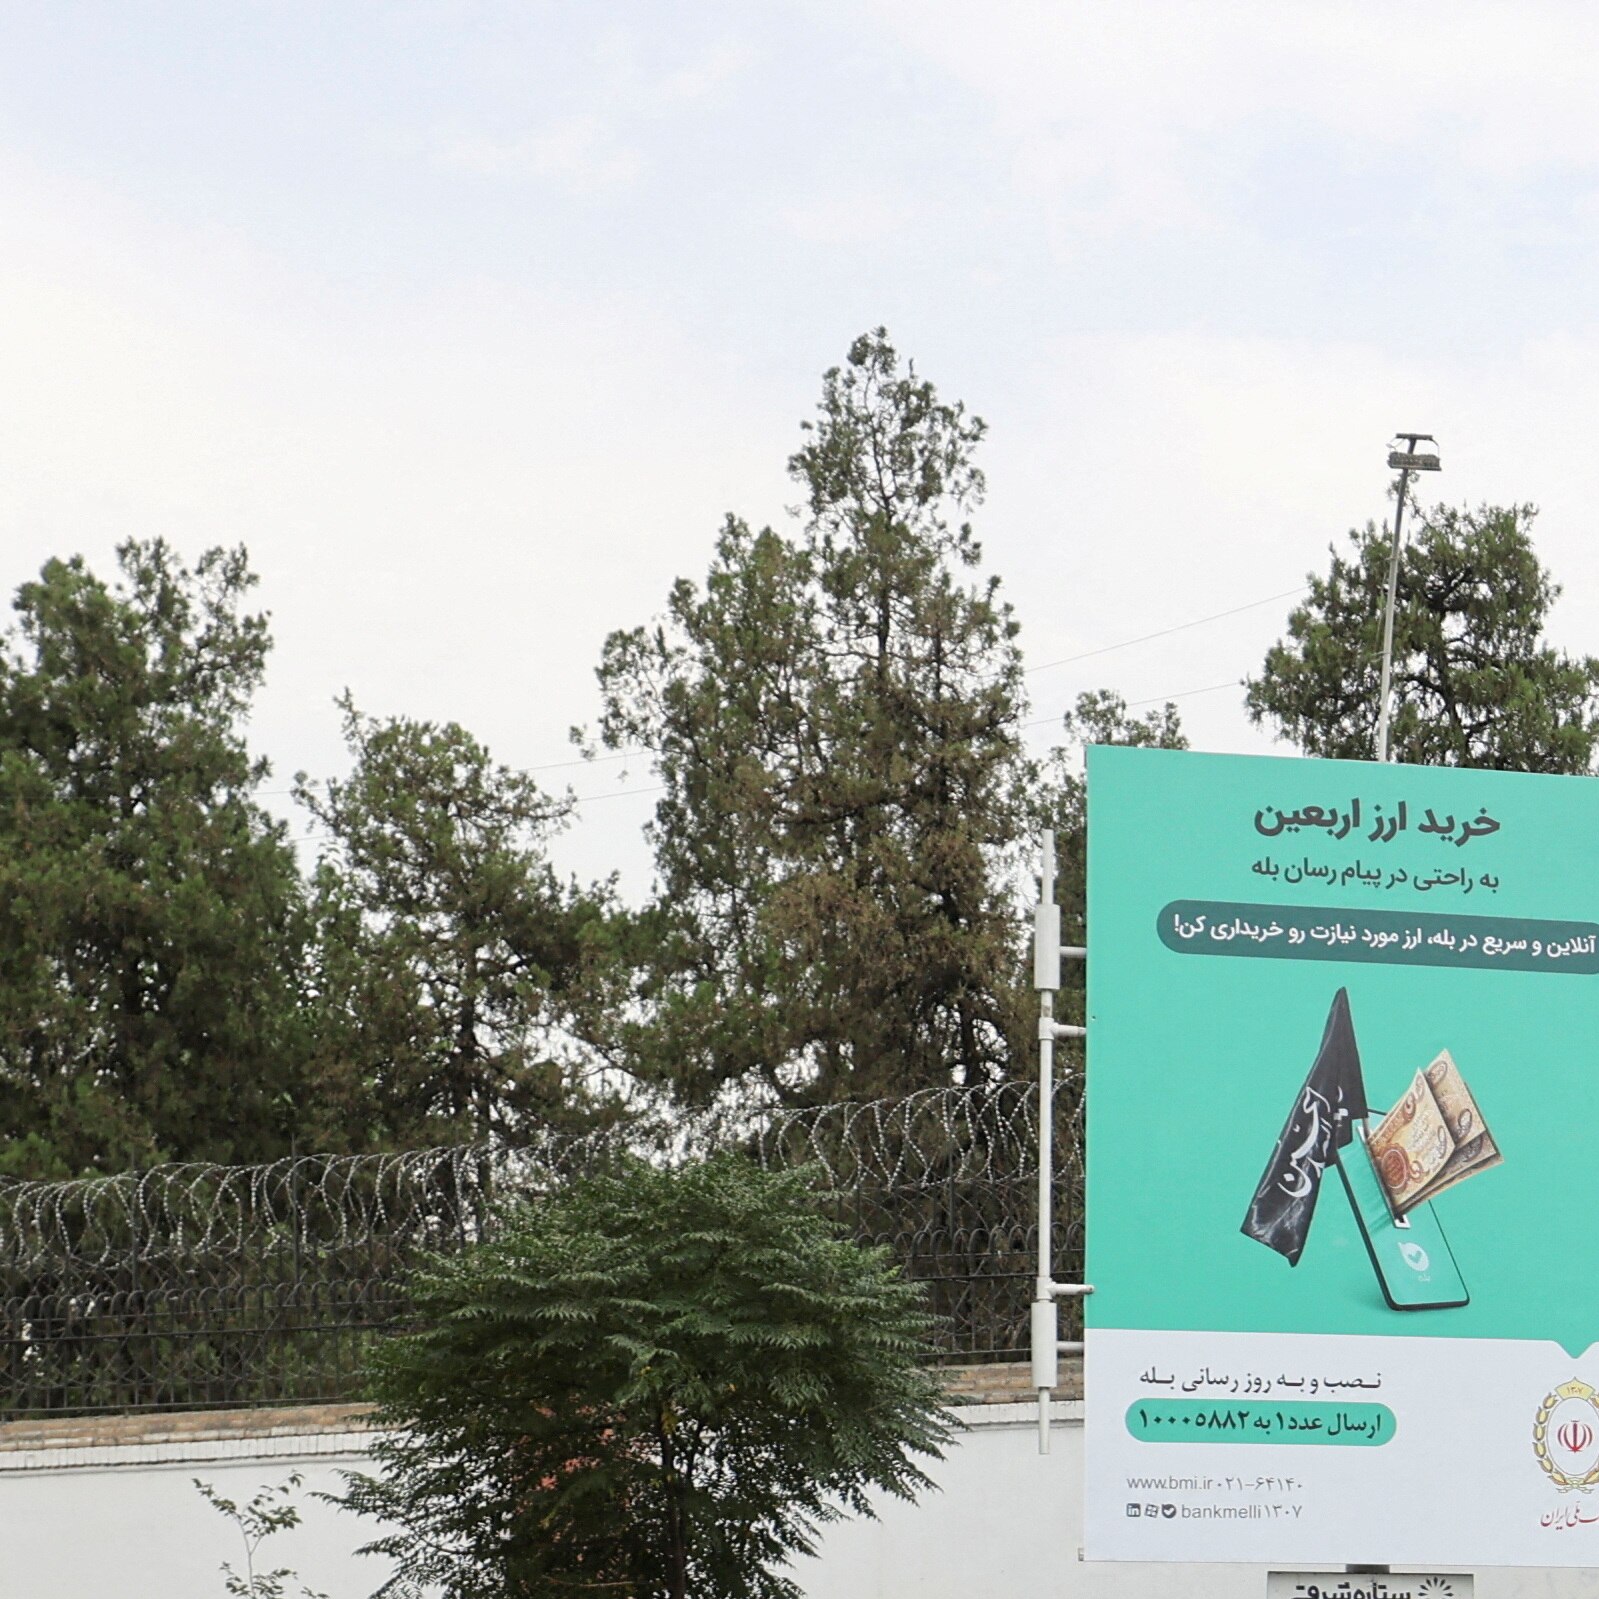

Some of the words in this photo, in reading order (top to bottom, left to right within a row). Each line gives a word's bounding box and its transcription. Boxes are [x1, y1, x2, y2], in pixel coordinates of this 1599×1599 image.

[1254, 797, 1360, 840] اربعین
[1368, 800, 1407, 843] ارز
[1417, 807, 1501, 847] خرید
[1251, 856, 1280, 882] بله
[1284, 857, 1337, 885] رسان
[1341, 860, 1382, 888] پیام
[1386, 868, 1408, 889] در
[1413, 867, 1473, 895] راحتی
[1479, 873, 1500, 894] به
[1174, 914, 1206, 938] کن!
[1210, 918, 1284, 942] خریداری
[1288, 928, 1306, 943] رو
[1310, 923, 1357, 945] نیازت
[1361, 928, 1399, 948] مورد
[1402, 928, 1422, 950] ارز
[1427, 929, 1456, 950] بله،
[1459, 934, 1478, 952] در
[1482, 935, 1527, 955] سریع
[1531, 940, 1542, 956] و
[1546, 935, 1597, 958] آنلاین
[1139, 1366, 1175, 1390] بله
[1181, 1368, 1239, 1394] رسانی
[1244, 1372, 1271, 1394] روز
[1277, 1373, 1305, 1393] به
[1310, 1377, 1319, 1394] و
[1323, 1372, 1382, 1394] نصب
[1138, 1409, 1250, 1430] ۱۰۰۰۵۸۸۲
[1253, 1418, 1271, 1435] به
[1287, 1416, 1323, 1431] عدد
[1327, 1412, 1381, 1439] ارسال
[1126, 1475, 1213, 1490] www.bmi.ir
[1540, 1506, 1568, 1530] ایران
